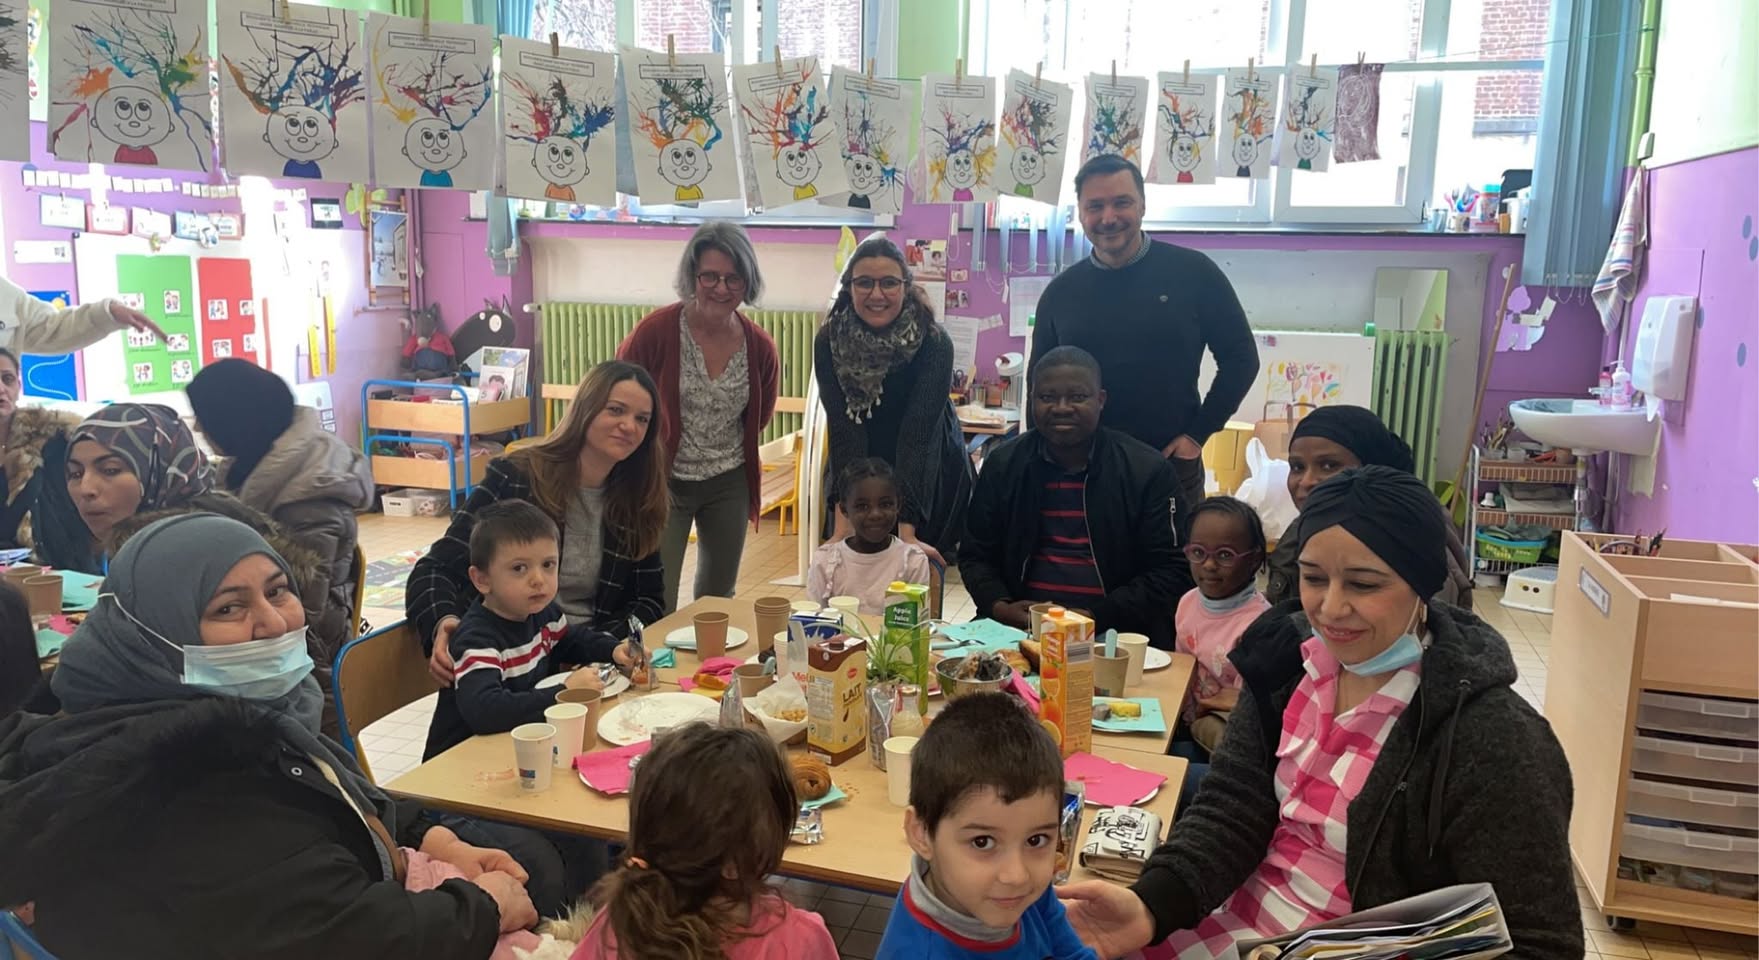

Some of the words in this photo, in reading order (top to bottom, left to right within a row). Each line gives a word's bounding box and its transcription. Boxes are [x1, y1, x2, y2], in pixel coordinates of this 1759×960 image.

[893, 606, 911, 615] Apple
[894, 614, 909, 622] Juice
[842, 682, 861, 702] LAIT
